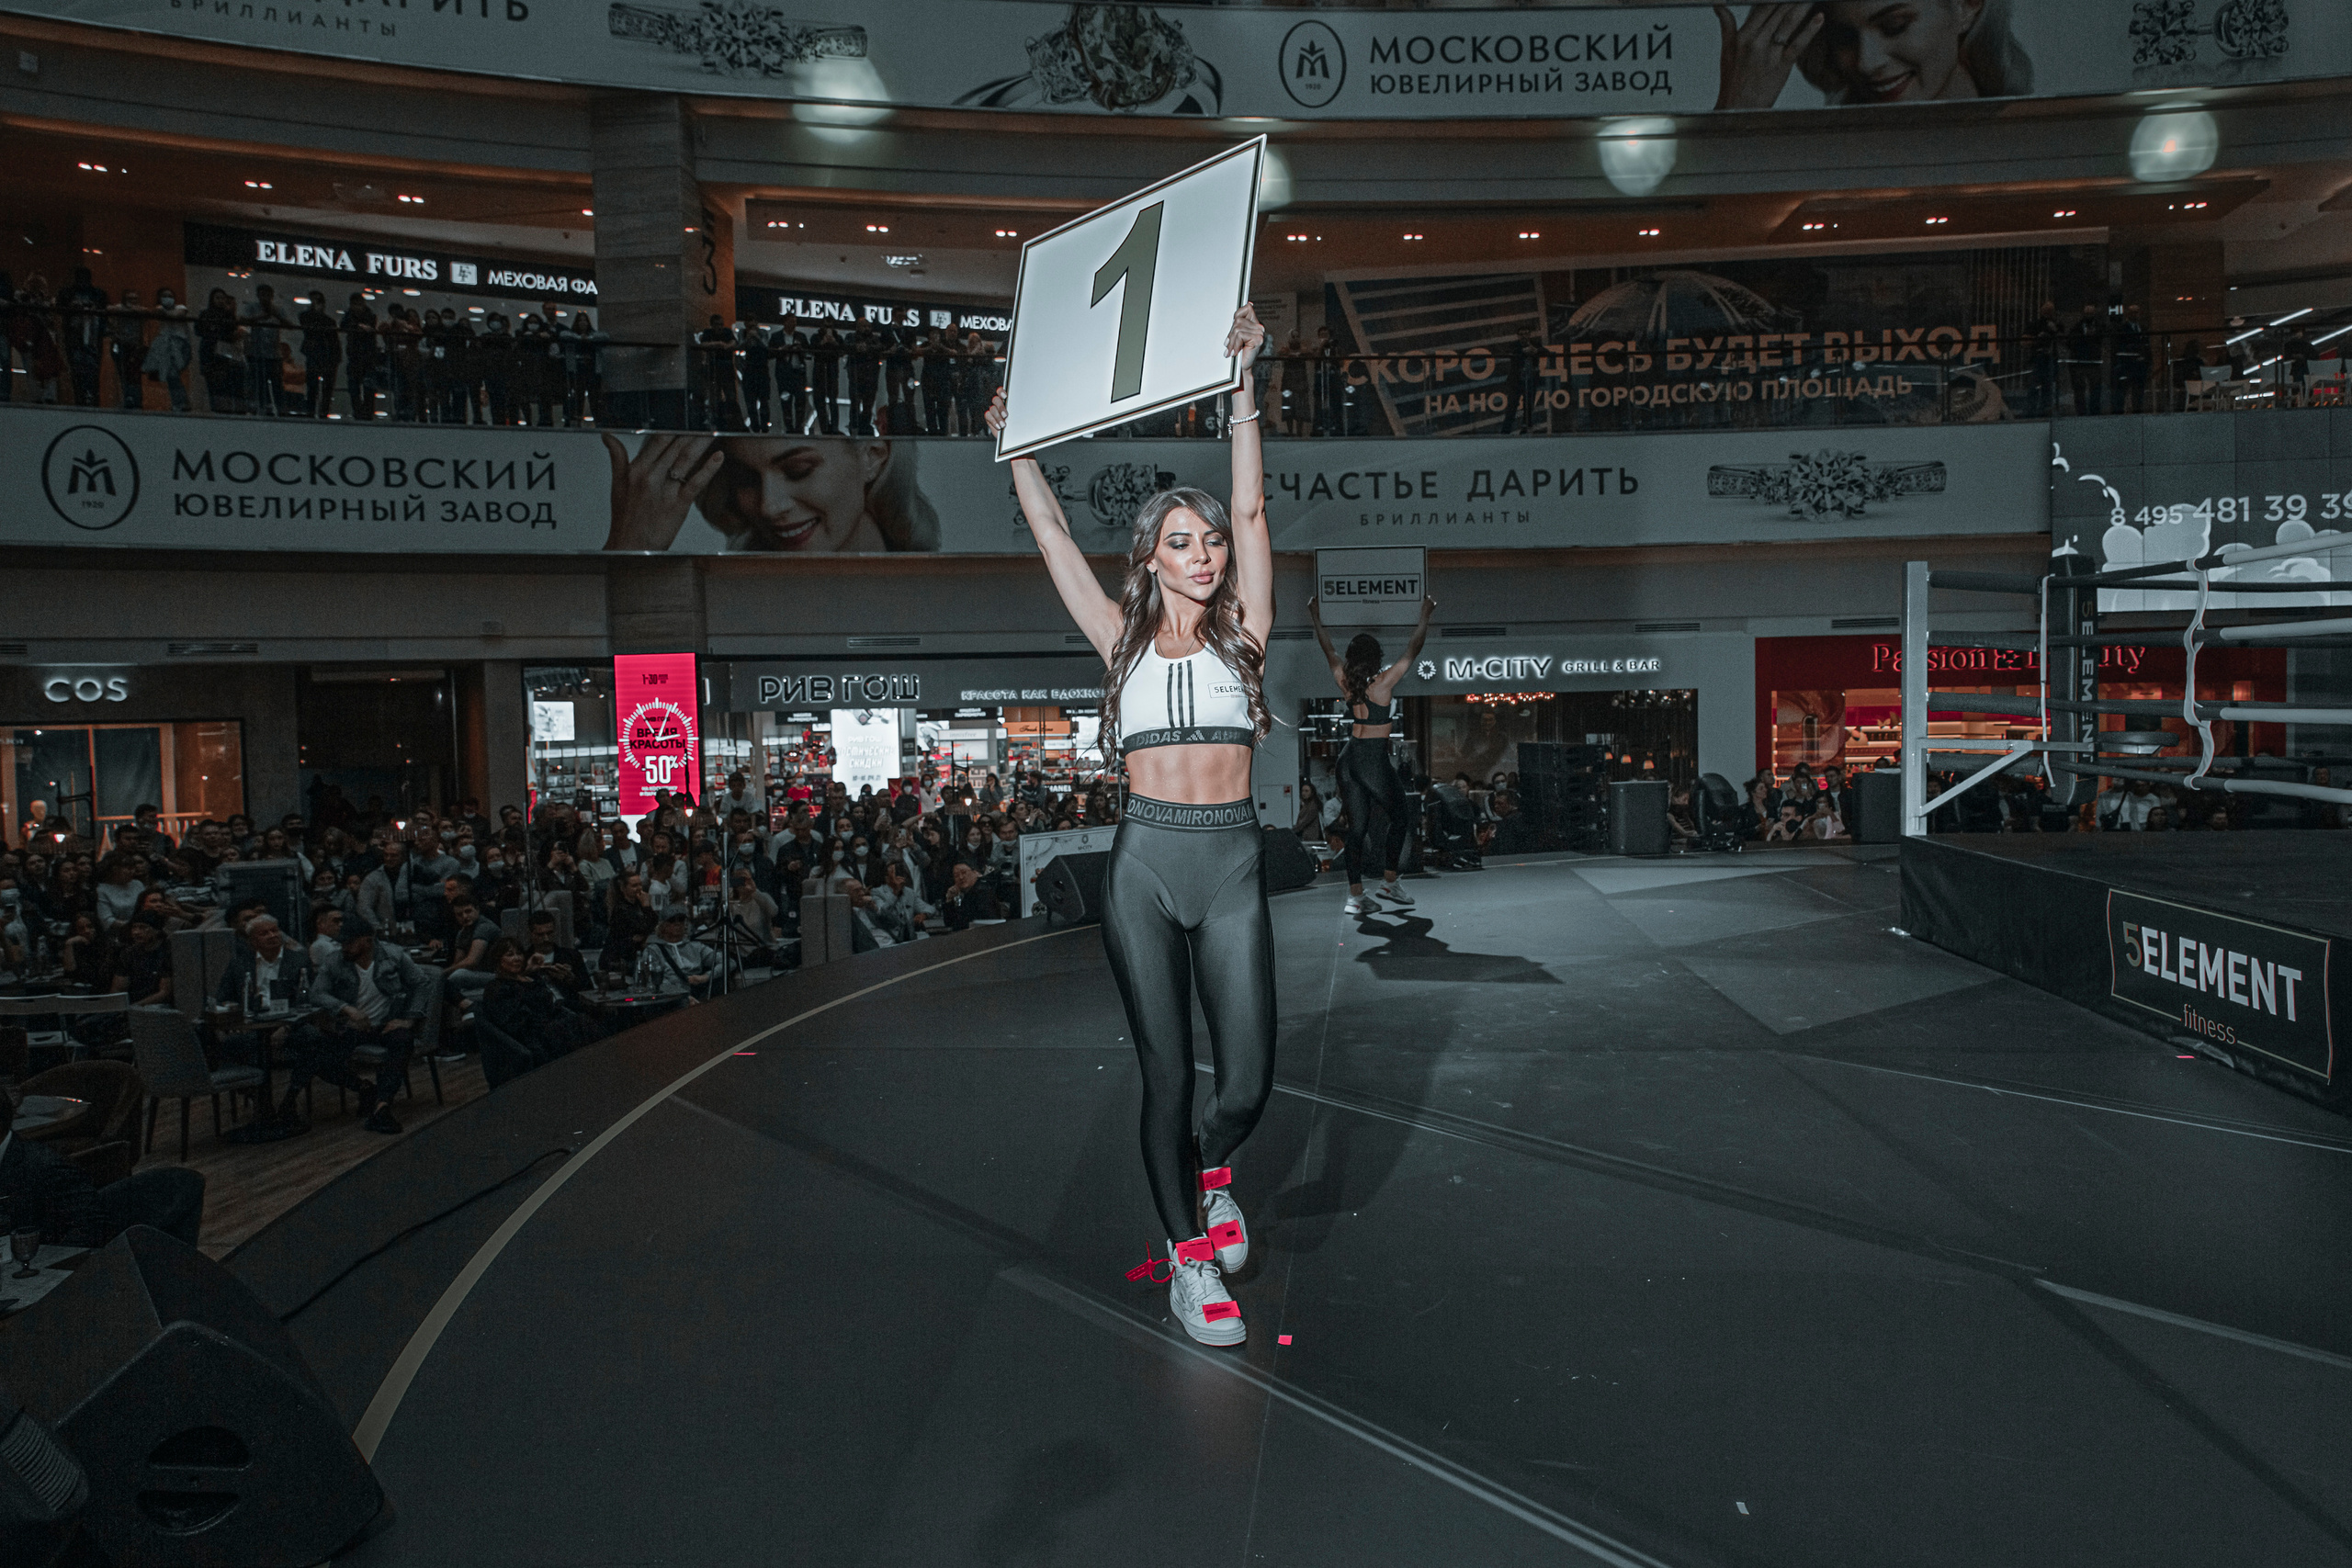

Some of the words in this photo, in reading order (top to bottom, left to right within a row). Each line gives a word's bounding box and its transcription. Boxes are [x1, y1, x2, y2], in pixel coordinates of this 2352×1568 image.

[1370, 24, 1673, 64] МОСКОВСКИЙ
[1370, 67, 1562, 95] ЮВЕЛИРНЫЙ
[1575, 70, 1673, 95] ЗАВОД
[256, 240, 356, 272] ELENA
[366, 253, 438, 280] FURS
[487, 269, 568, 292] МЕХОВАЯ
[779, 297, 855, 321] ELENA
[864, 304, 920, 327] FUS
[1091, 199, 1164, 404] 1
[1538, 340, 1652, 381] ДЕСЬ
[1667, 333, 1812, 374] БУДЕТ
[1825, 325, 2001, 366] ВЫХОД
[1426, 393, 1461, 415] НА
[1761, 376, 1913, 402] ПЛОЩАДЬ
[173, 448, 557, 491] МОСКОВСКИЙ
[1467, 467, 1639, 502] ДАРИТЬ
[175, 492, 425, 522] ЮВЕЛИРНЫЙ
[441, 501, 557, 529] ЗАВОД
[1360, 510, 1531, 526] БРИЛЛИАНТЫ
[2110, 507, 2126, 526] 8
[2134, 506, 2183, 525] 495
[2193, 497, 2250, 523] 481
[2264, 494, 2307, 522] 39
[1324, 580, 1418, 596] 5ELEMENT
[1564, 660, 1611, 673] GRILL
[1615, 660, 1624, 672] &
[1629, 660, 1660, 671] BAR
[44, 677, 128, 703] COS
[759, 675, 834, 704] РИВ
[842, 674, 920, 703] ГОШ
[961, 690, 1018, 701] КРАСОТА
[1022, 689, 1047, 700] КАК
[629, 739, 685, 750] КРАСОТЫ
[637, 728, 677, 738] ВРЕМЯ
[2122, 920, 2301, 1021] 5ELEMENT
[2183, 1003, 2235, 1045] fitness
